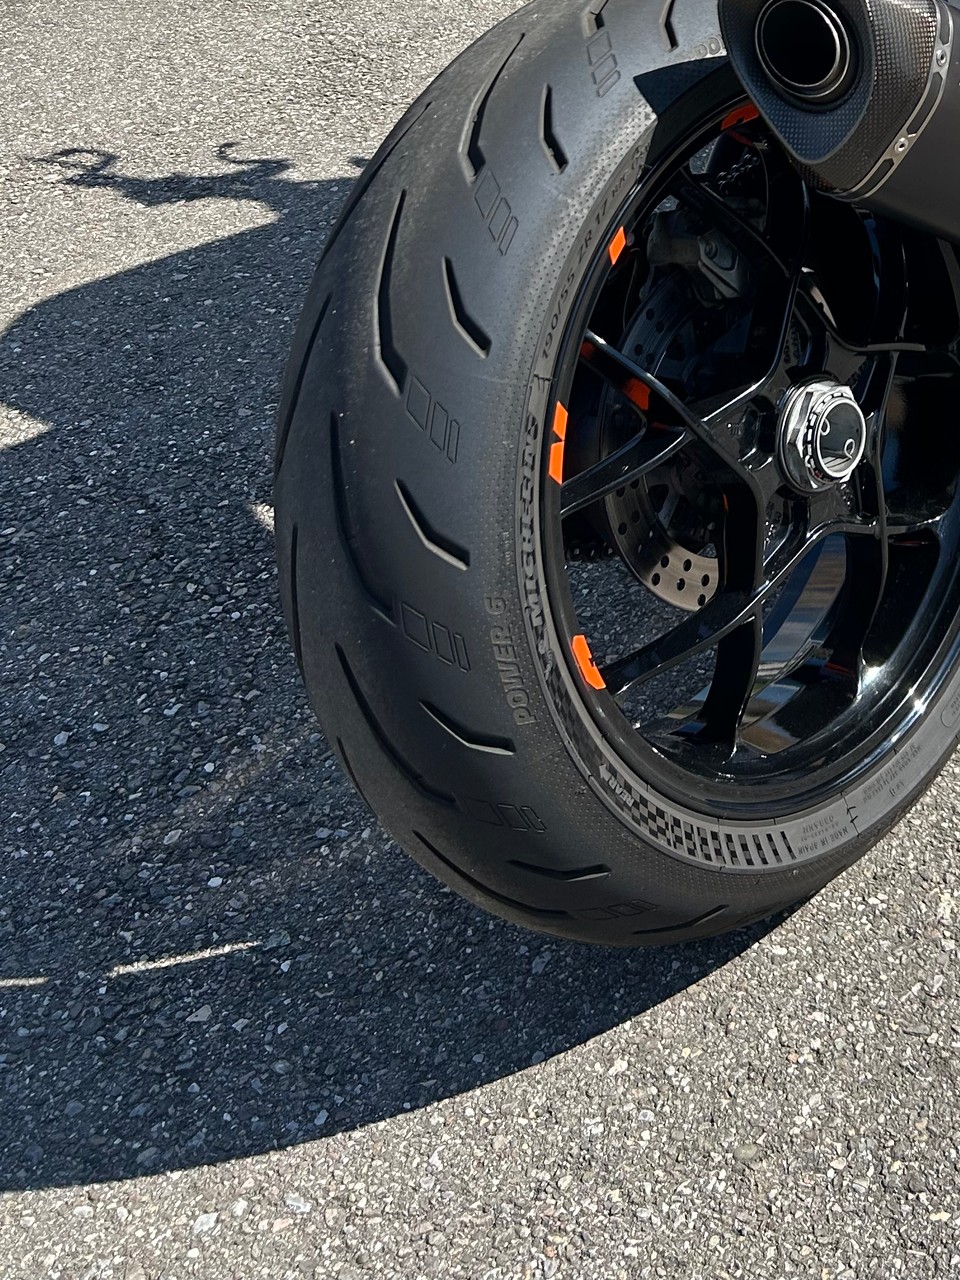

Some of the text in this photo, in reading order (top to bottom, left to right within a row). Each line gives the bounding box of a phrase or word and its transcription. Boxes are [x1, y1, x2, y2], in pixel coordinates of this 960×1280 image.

[542, 272, 577, 359] 190/55
[577, 230, 593, 259] ZR
[520, 434, 545, 626] MICHELIN
[485, 596, 540, 726] POWER 6
[609, 776, 635, 807] REAR
